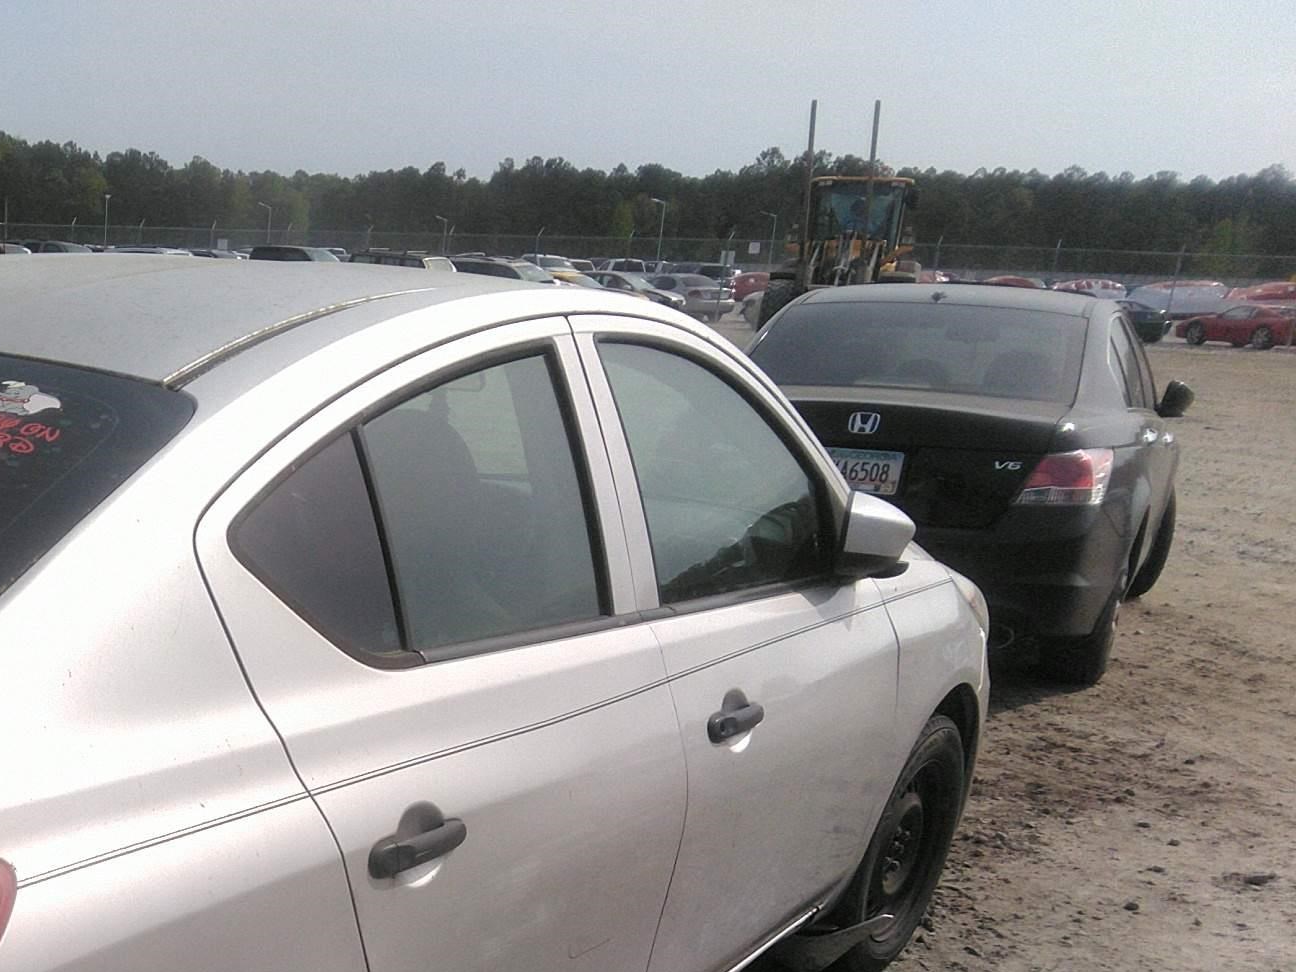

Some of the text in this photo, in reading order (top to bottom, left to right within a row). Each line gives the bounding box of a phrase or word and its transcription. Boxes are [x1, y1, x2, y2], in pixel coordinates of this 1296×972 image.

[20, 423, 61, 442] ON
[834, 459, 890, 484] A6508
[994, 460, 1024, 471] V6
